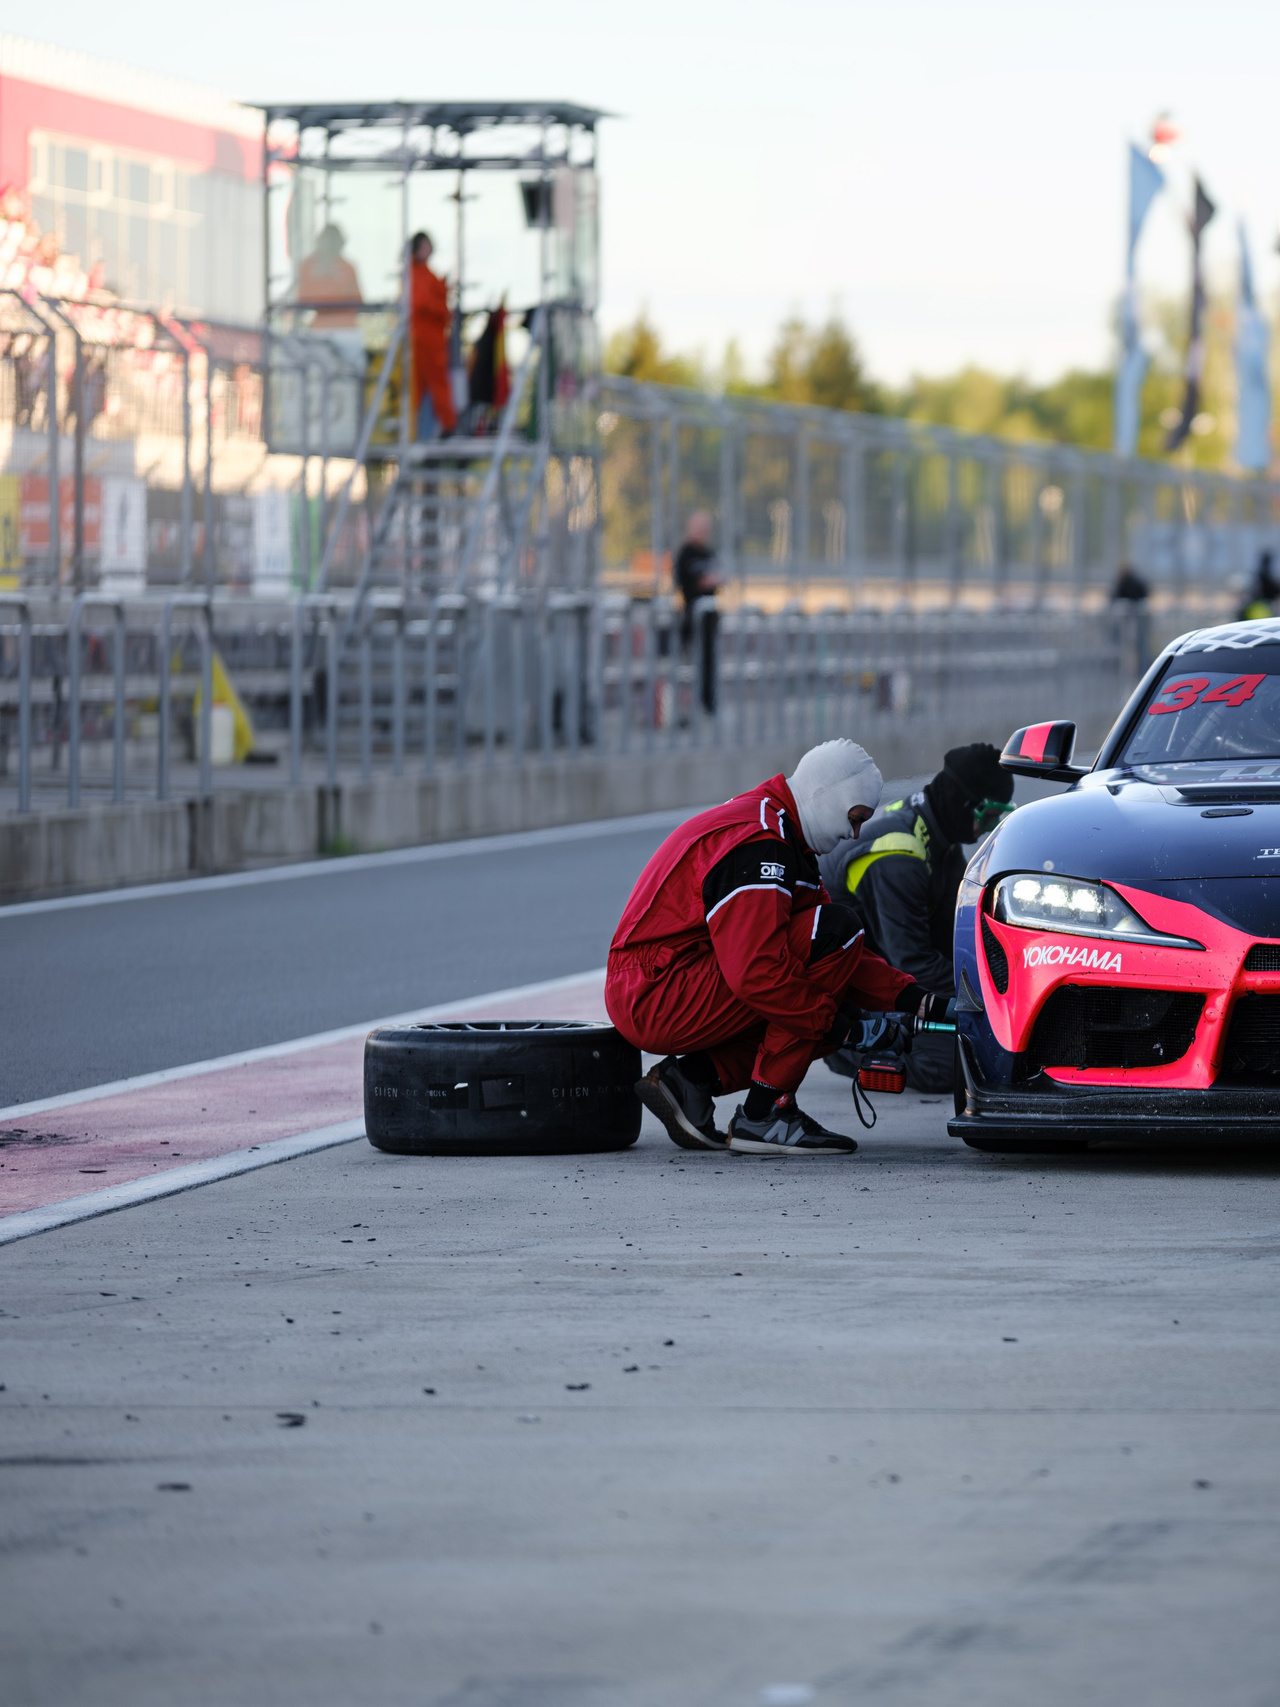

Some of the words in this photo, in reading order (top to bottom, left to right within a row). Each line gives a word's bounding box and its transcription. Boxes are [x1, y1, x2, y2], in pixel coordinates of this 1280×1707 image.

[1148, 673, 1266, 716] 34
[760, 865, 785, 878] OMP
[1023, 945, 1122, 973] YOKOHAMA
